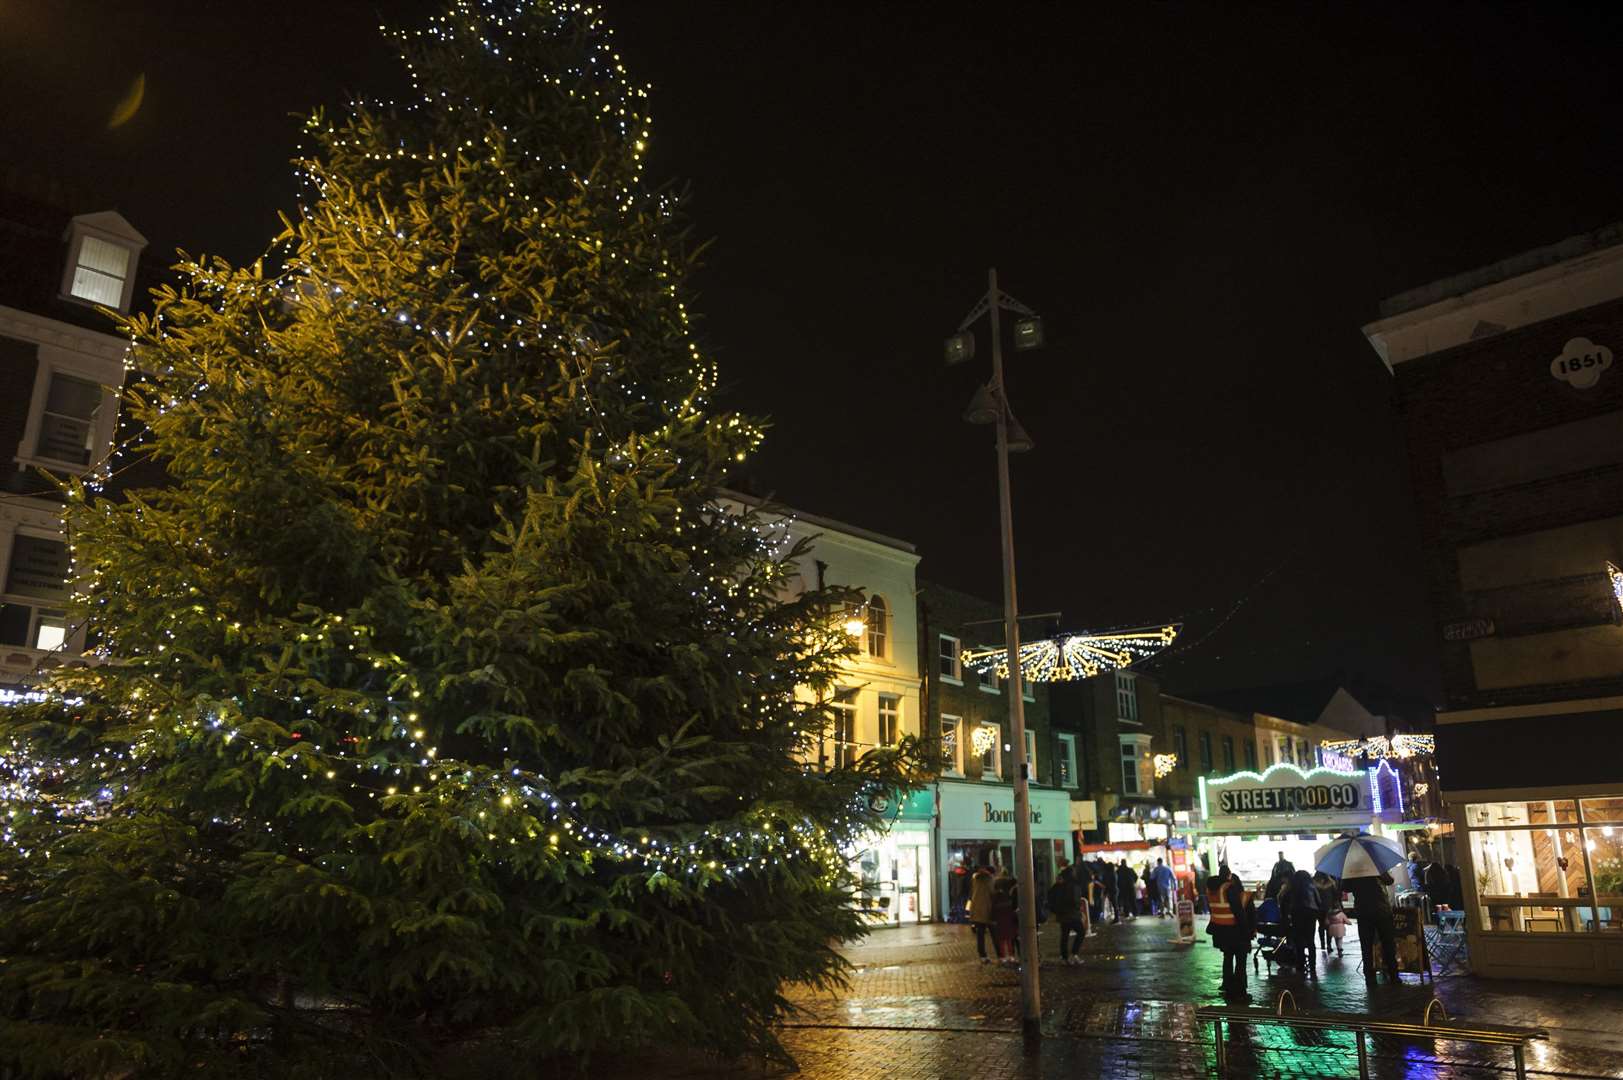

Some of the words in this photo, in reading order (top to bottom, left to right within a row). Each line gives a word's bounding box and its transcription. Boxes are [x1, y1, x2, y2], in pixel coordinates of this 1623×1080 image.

[1560, 352, 1603, 374] 1851
[1220, 787, 1281, 811] STREET
[1284, 785, 1329, 808] FOOD
[984, 801, 1042, 824] Bonmhé
